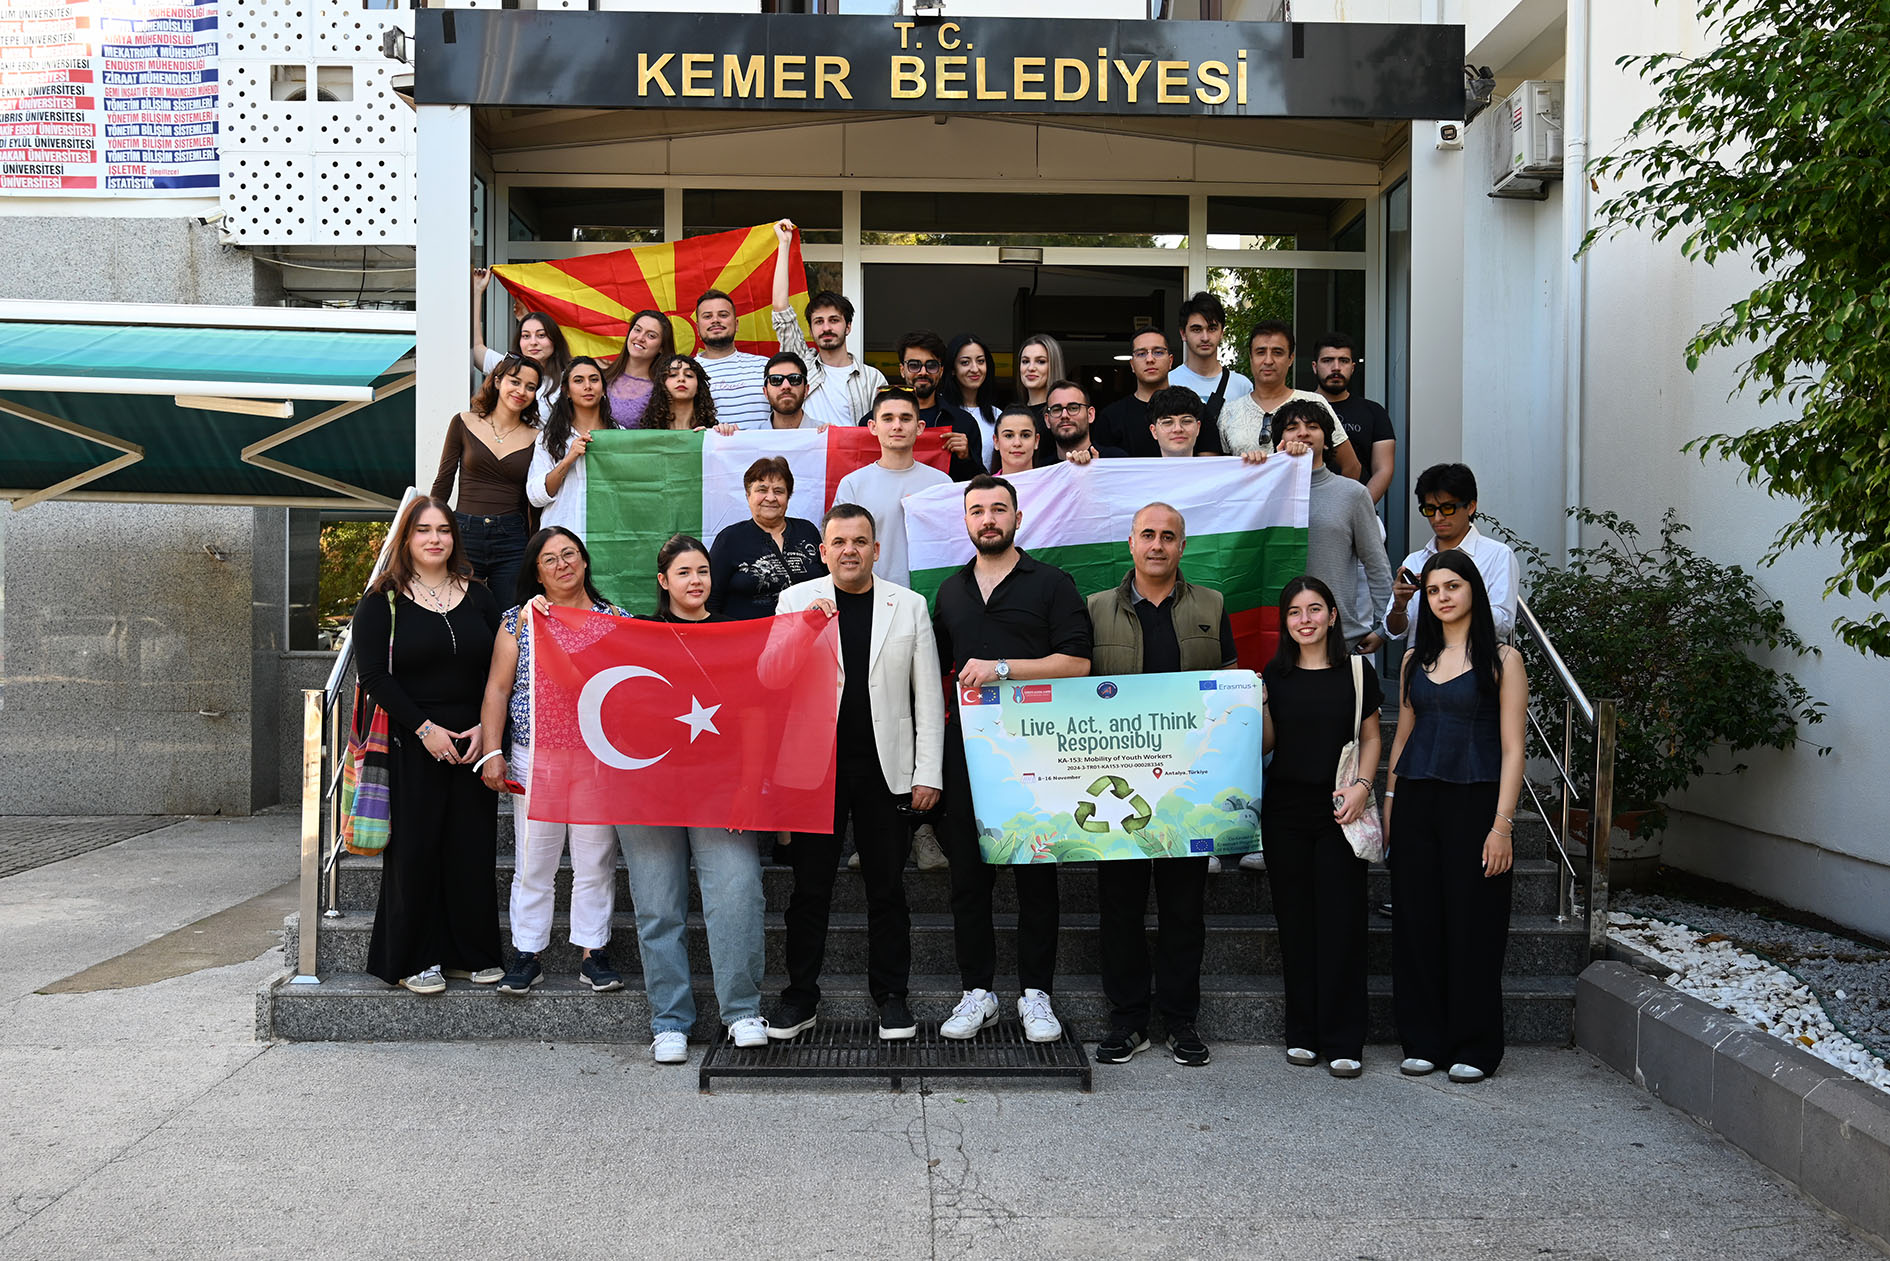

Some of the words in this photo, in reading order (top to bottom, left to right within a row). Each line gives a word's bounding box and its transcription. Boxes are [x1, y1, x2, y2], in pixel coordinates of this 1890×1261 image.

[893, 22, 922, 49] T.
[937, 22, 974, 50] C.
[104, 45, 158, 58] MEKATRONİK
[104, 70, 137, 84] ZİRAAT
[139, 70, 201, 84] MÜHENDİSLİĞİ
[637, 53, 853, 100] KEMER
[890, 47, 1247, 105] BELEDİYESİ
[106, 98, 139, 110] YÖNETİM
[141, 97, 171, 111] BİLİŞİM
[173, 94, 213, 110] SİSTEMLERİ
[107, 111, 139, 123] YÖNETİM
[142, 111, 171, 124] BİLİŞİM
[174, 110, 213, 123] SİSTEMLERİ
[107, 123, 139, 136] YÖNETİM
[141, 123, 172, 136] BİLİŞİM
[174, 121, 213, 136] SİSTEMLERİ
[34, 136, 95, 149] ÜNİVERSİTESİ
[108, 137, 139, 149] YÖNETİM
[142, 137, 172, 149] BİLİŞİM
[175, 135, 214, 149] SİSTEMLERİ
[108, 149, 140, 162] YÖNETİM
[142, 149, 172, 163] BİLİŞİM
[174, 147, 215, 162] SİSTEMLERİ
[2, 162, 64, 175] ÜNİVERSİTESİ
[109, 164, 147, 175] İŞLETME
[1, 175, 61, 188] ÜNİVERSİTESİ
[108, 176, 155, 189] İSTATİSTİK
[1067, 716, 1102, 735] Act,
[1109, 714, 1142, 732] and
[1148, 712, 1198, 731] Think
[1057, 731, 1162, 754] Responsibly
[1084, 755, 1111, 763] Mobility
